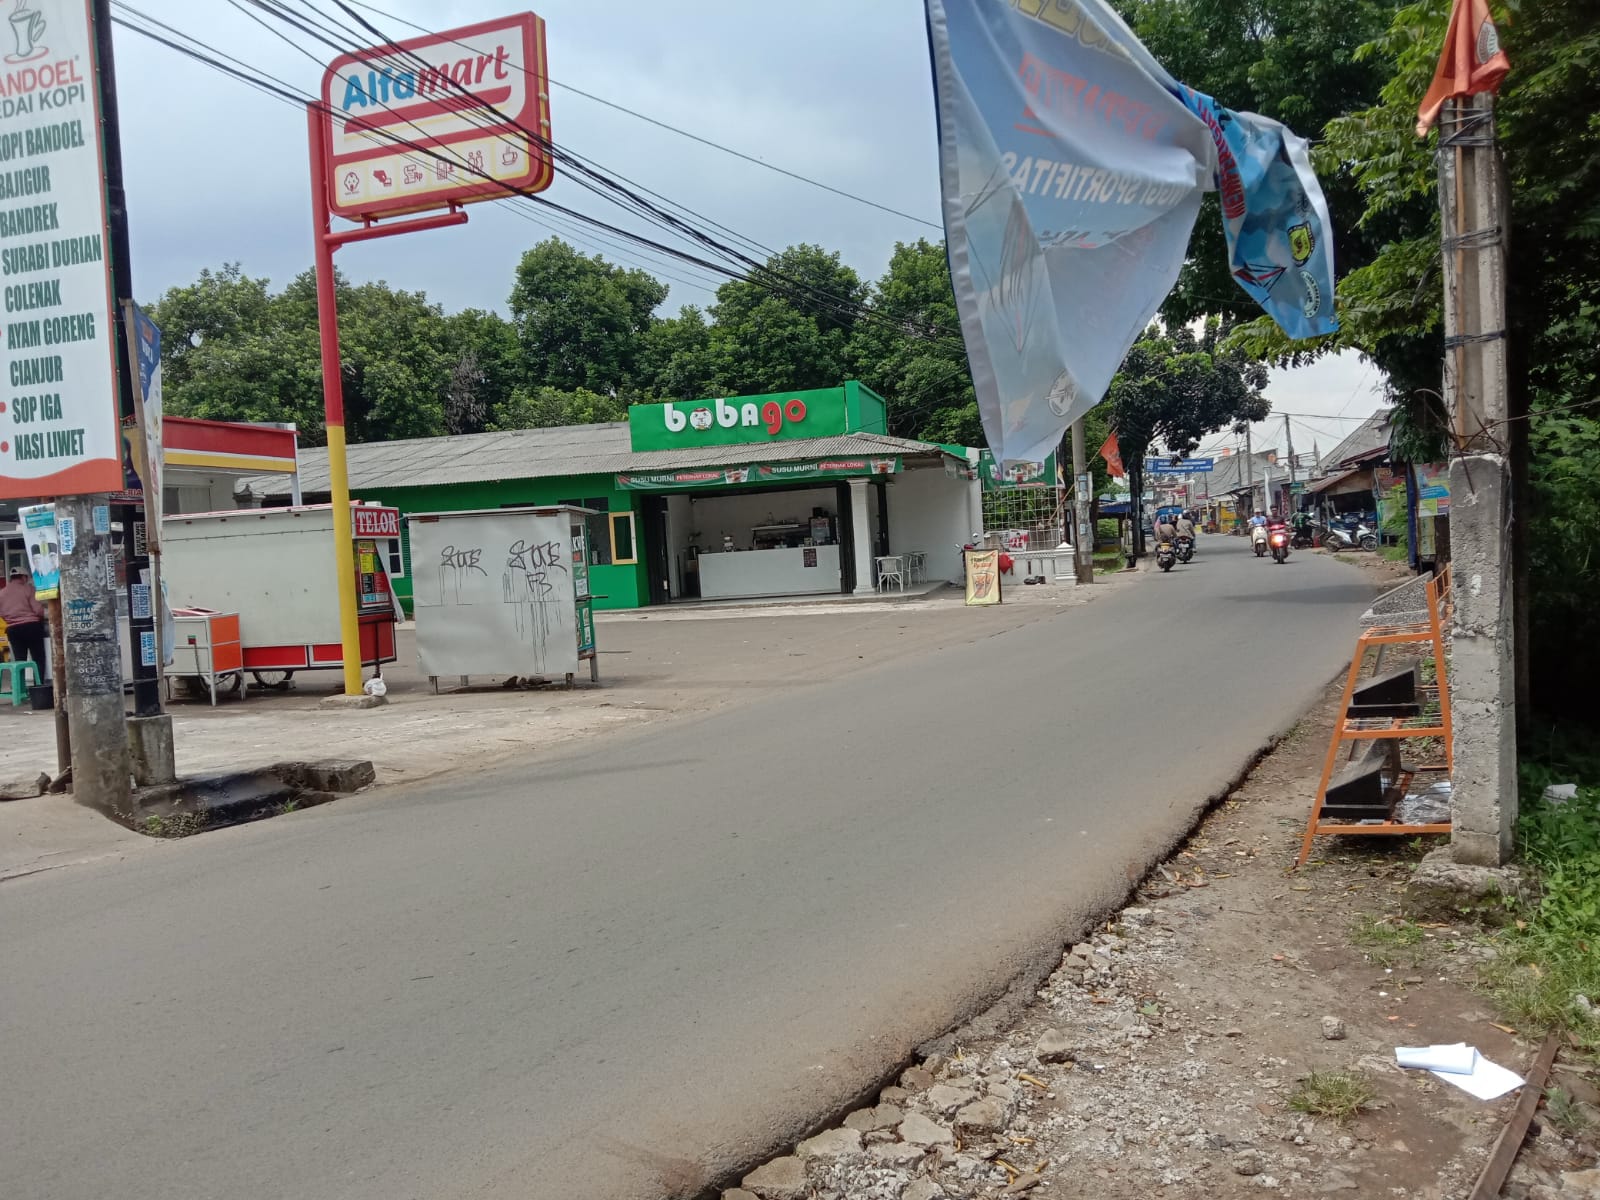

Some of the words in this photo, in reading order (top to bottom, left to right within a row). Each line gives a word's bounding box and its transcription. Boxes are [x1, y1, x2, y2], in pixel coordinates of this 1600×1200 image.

[342, 45, 510, 111] Alfamart
[39, 84, 86, 110] KOPI
[26, 119, 85, 156] BANDOEL
[0, 165, 51, 200] BAJIGUR
[1, 202, 59, 238] BANDREK
[2, 244, 50, 276] SURABI
[51, 234, 102, 269] DURIAN
[4, 279, 62, 313] COLENAK
[7, 315, 41, 350] AYAM
[43, 312, 96, 345] GORENG
[10, 355, 64, 388] CIANJUR
[12, 396, 37, 424] SOP
[39, 393, 63, 422] IGA
[14, 432, 45, 461] NASI
[46, 428, 85, 459] LIWET
[651, 474, 675, 483] MURNI
[772, 465, 792, 473] SUSU
[793, 463, 818, 472] MURNI
[356, 510, 398, 534] TELOR
